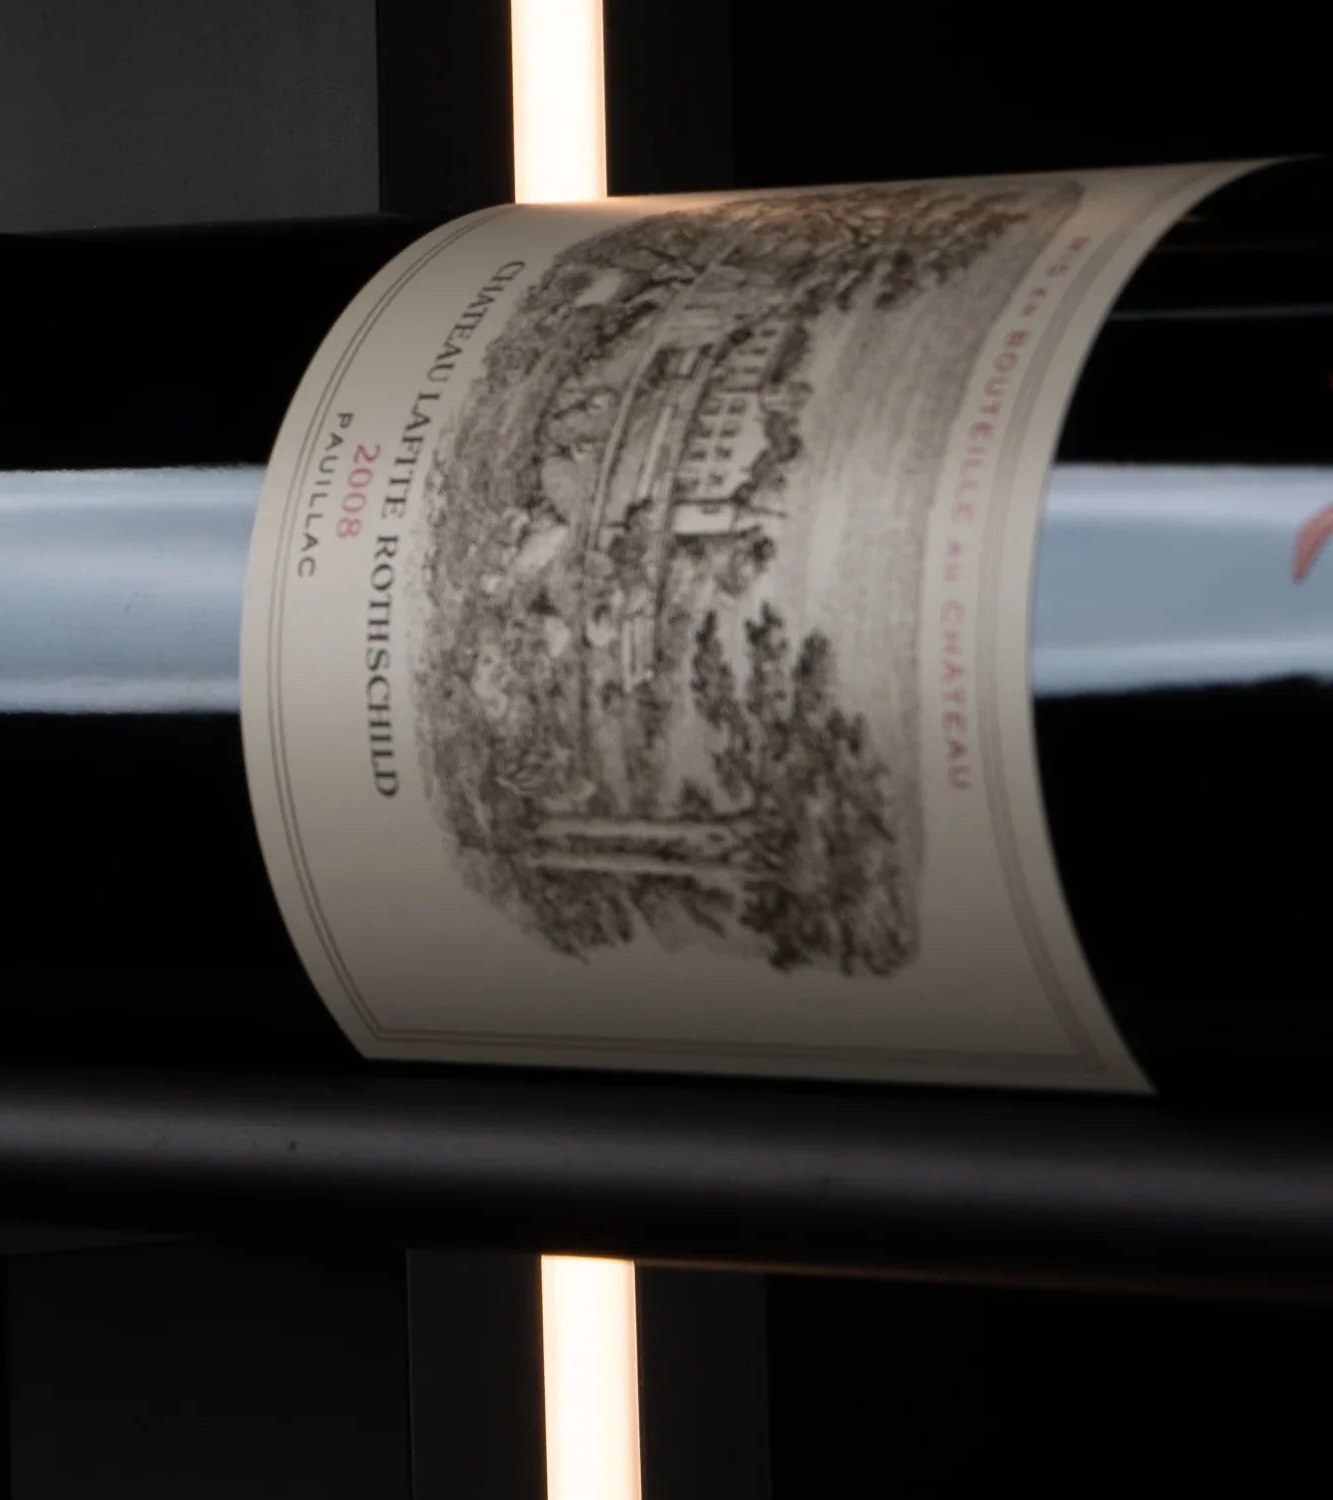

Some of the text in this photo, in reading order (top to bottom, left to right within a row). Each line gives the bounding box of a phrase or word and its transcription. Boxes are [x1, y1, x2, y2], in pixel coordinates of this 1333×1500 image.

[296, 410, 355, 581] PAUILLAC
[335, 441, 382, 542] 2008
[365, 258, 527, 799] CHATEAU LAFITE ROTHSCHILD
